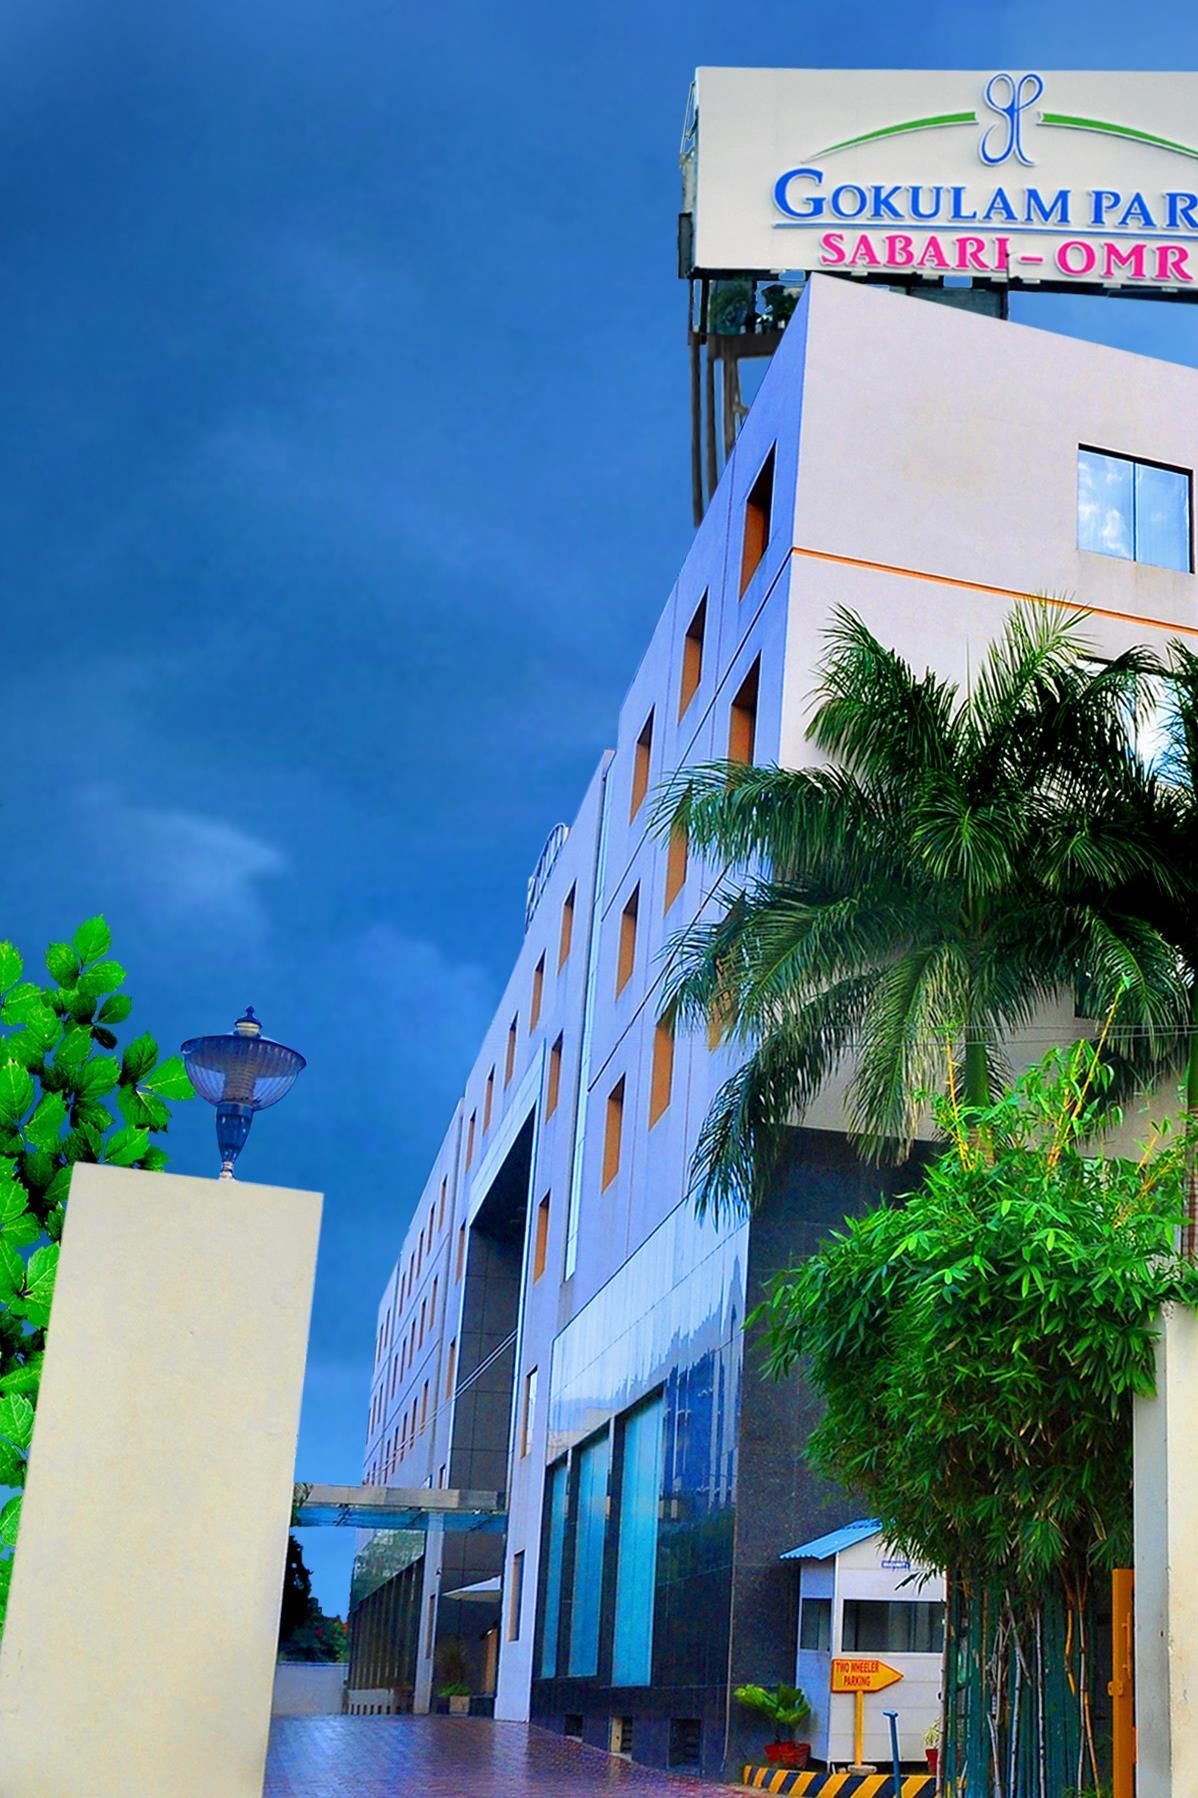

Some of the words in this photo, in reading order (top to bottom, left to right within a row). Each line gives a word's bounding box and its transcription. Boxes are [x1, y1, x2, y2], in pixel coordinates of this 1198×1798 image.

[773, 166, 1072, 225] GOKULAM
[836, 1662, 849, 1674] TWO
[850, 1662, 880, 1674] WHEELER
[844, 1675, 871, 1687] PARKING
